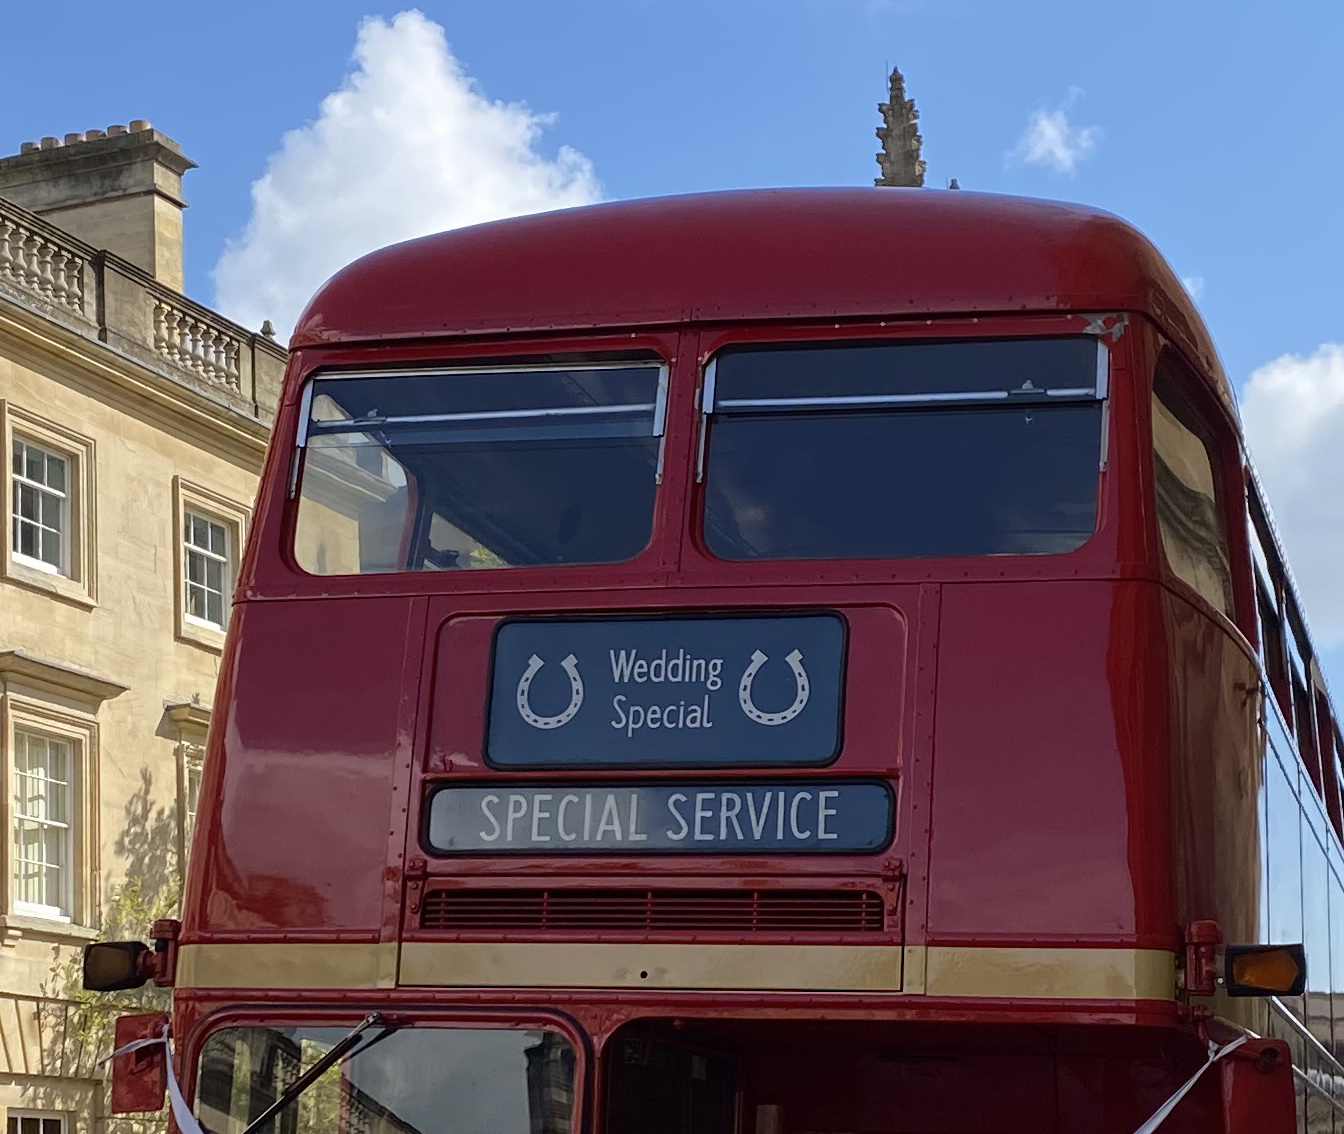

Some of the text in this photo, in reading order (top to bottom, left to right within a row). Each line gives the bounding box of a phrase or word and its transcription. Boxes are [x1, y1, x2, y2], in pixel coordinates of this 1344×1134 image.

[609, 648, 724, 691] Wedding
[610, 694, 713, 738] Special
[479, 790, 839, 842] SPECIAL SERVICE
